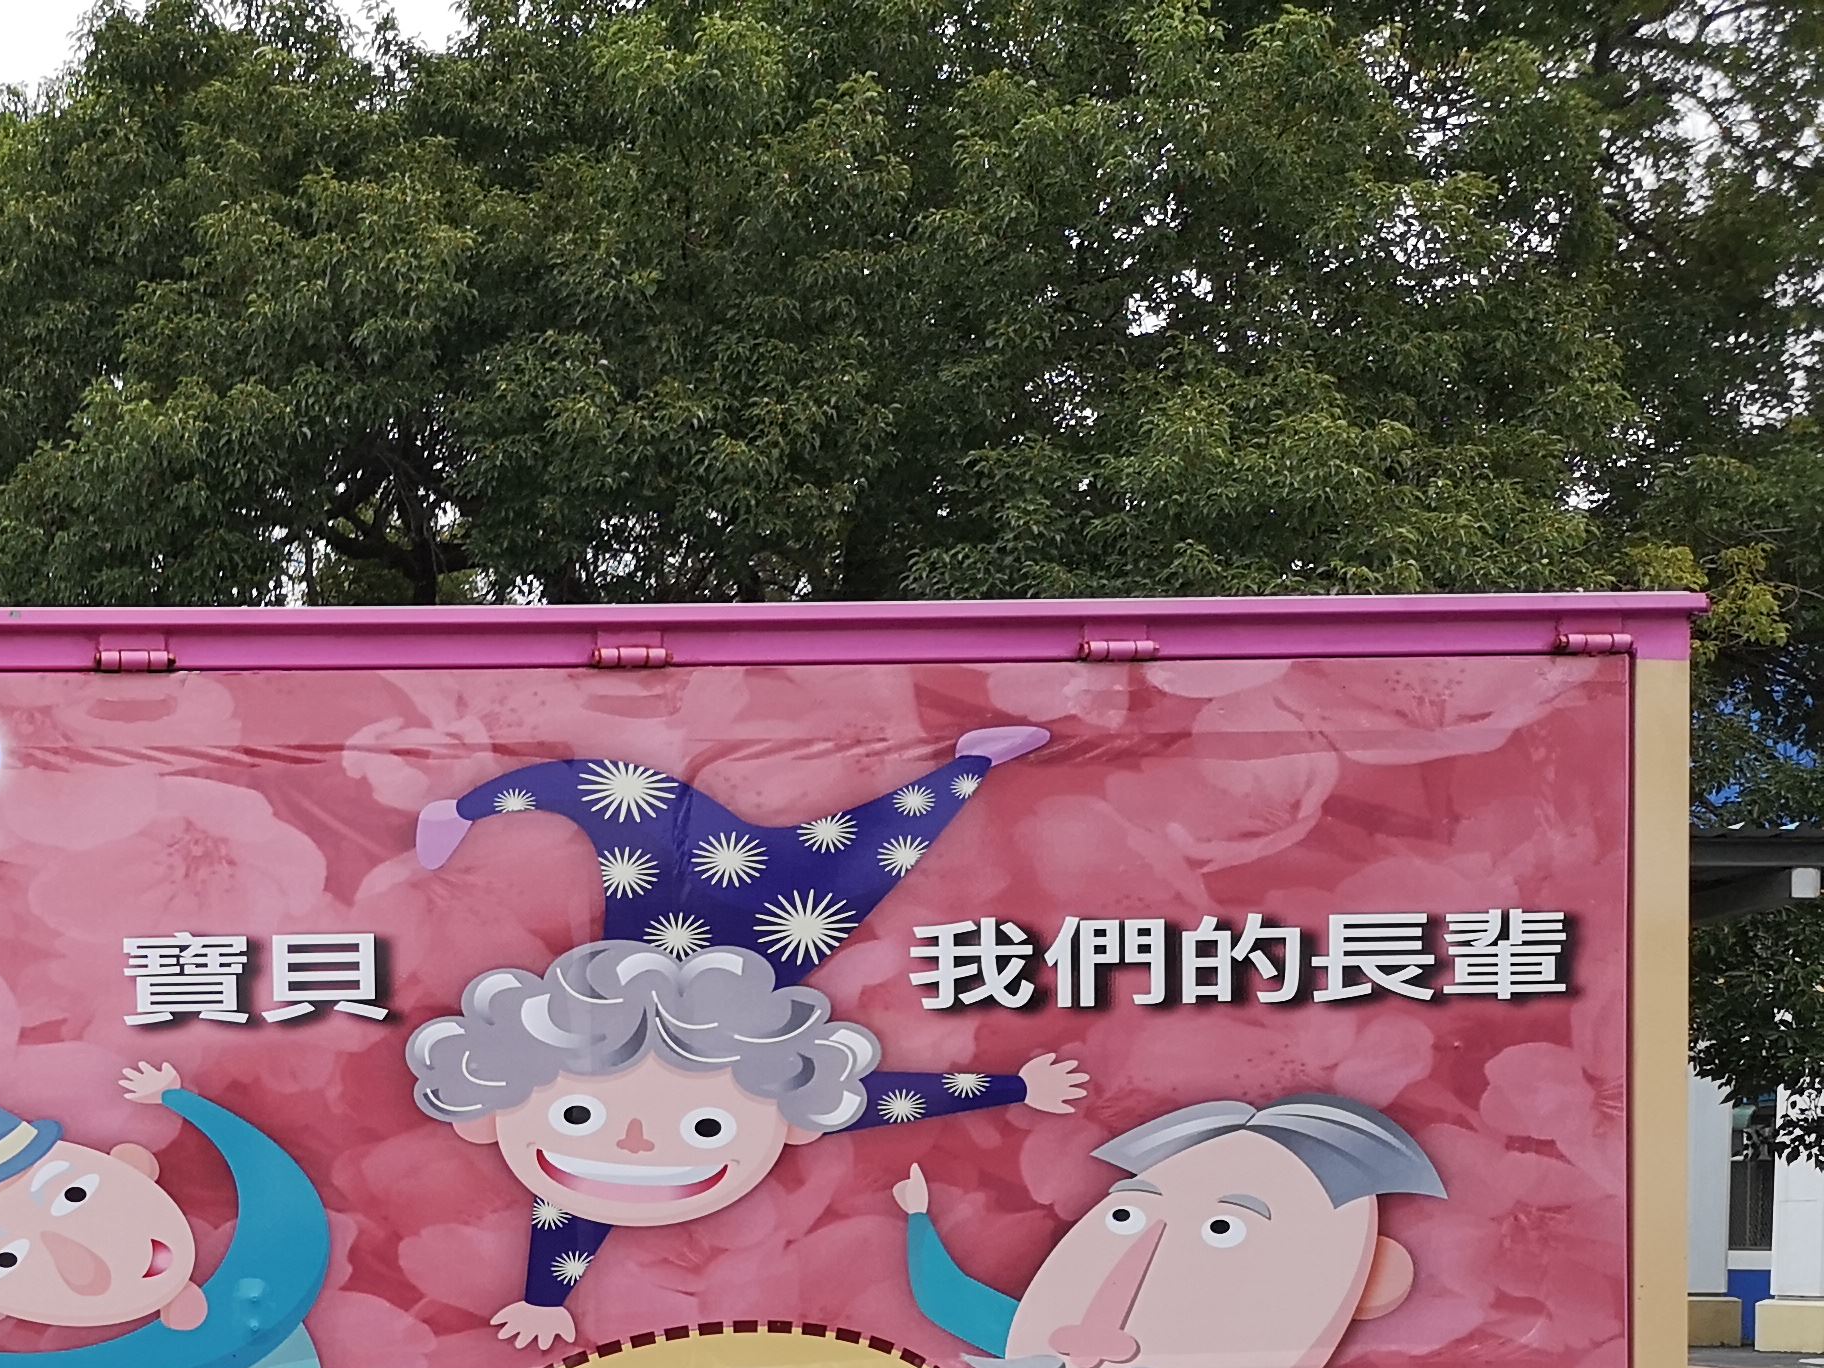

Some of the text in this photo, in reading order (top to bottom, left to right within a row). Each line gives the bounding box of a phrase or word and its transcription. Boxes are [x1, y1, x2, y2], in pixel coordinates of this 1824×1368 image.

[123, 931, 389, 1026] 寶貝
[909, 908, 1568, 1010] 我們的長輩
